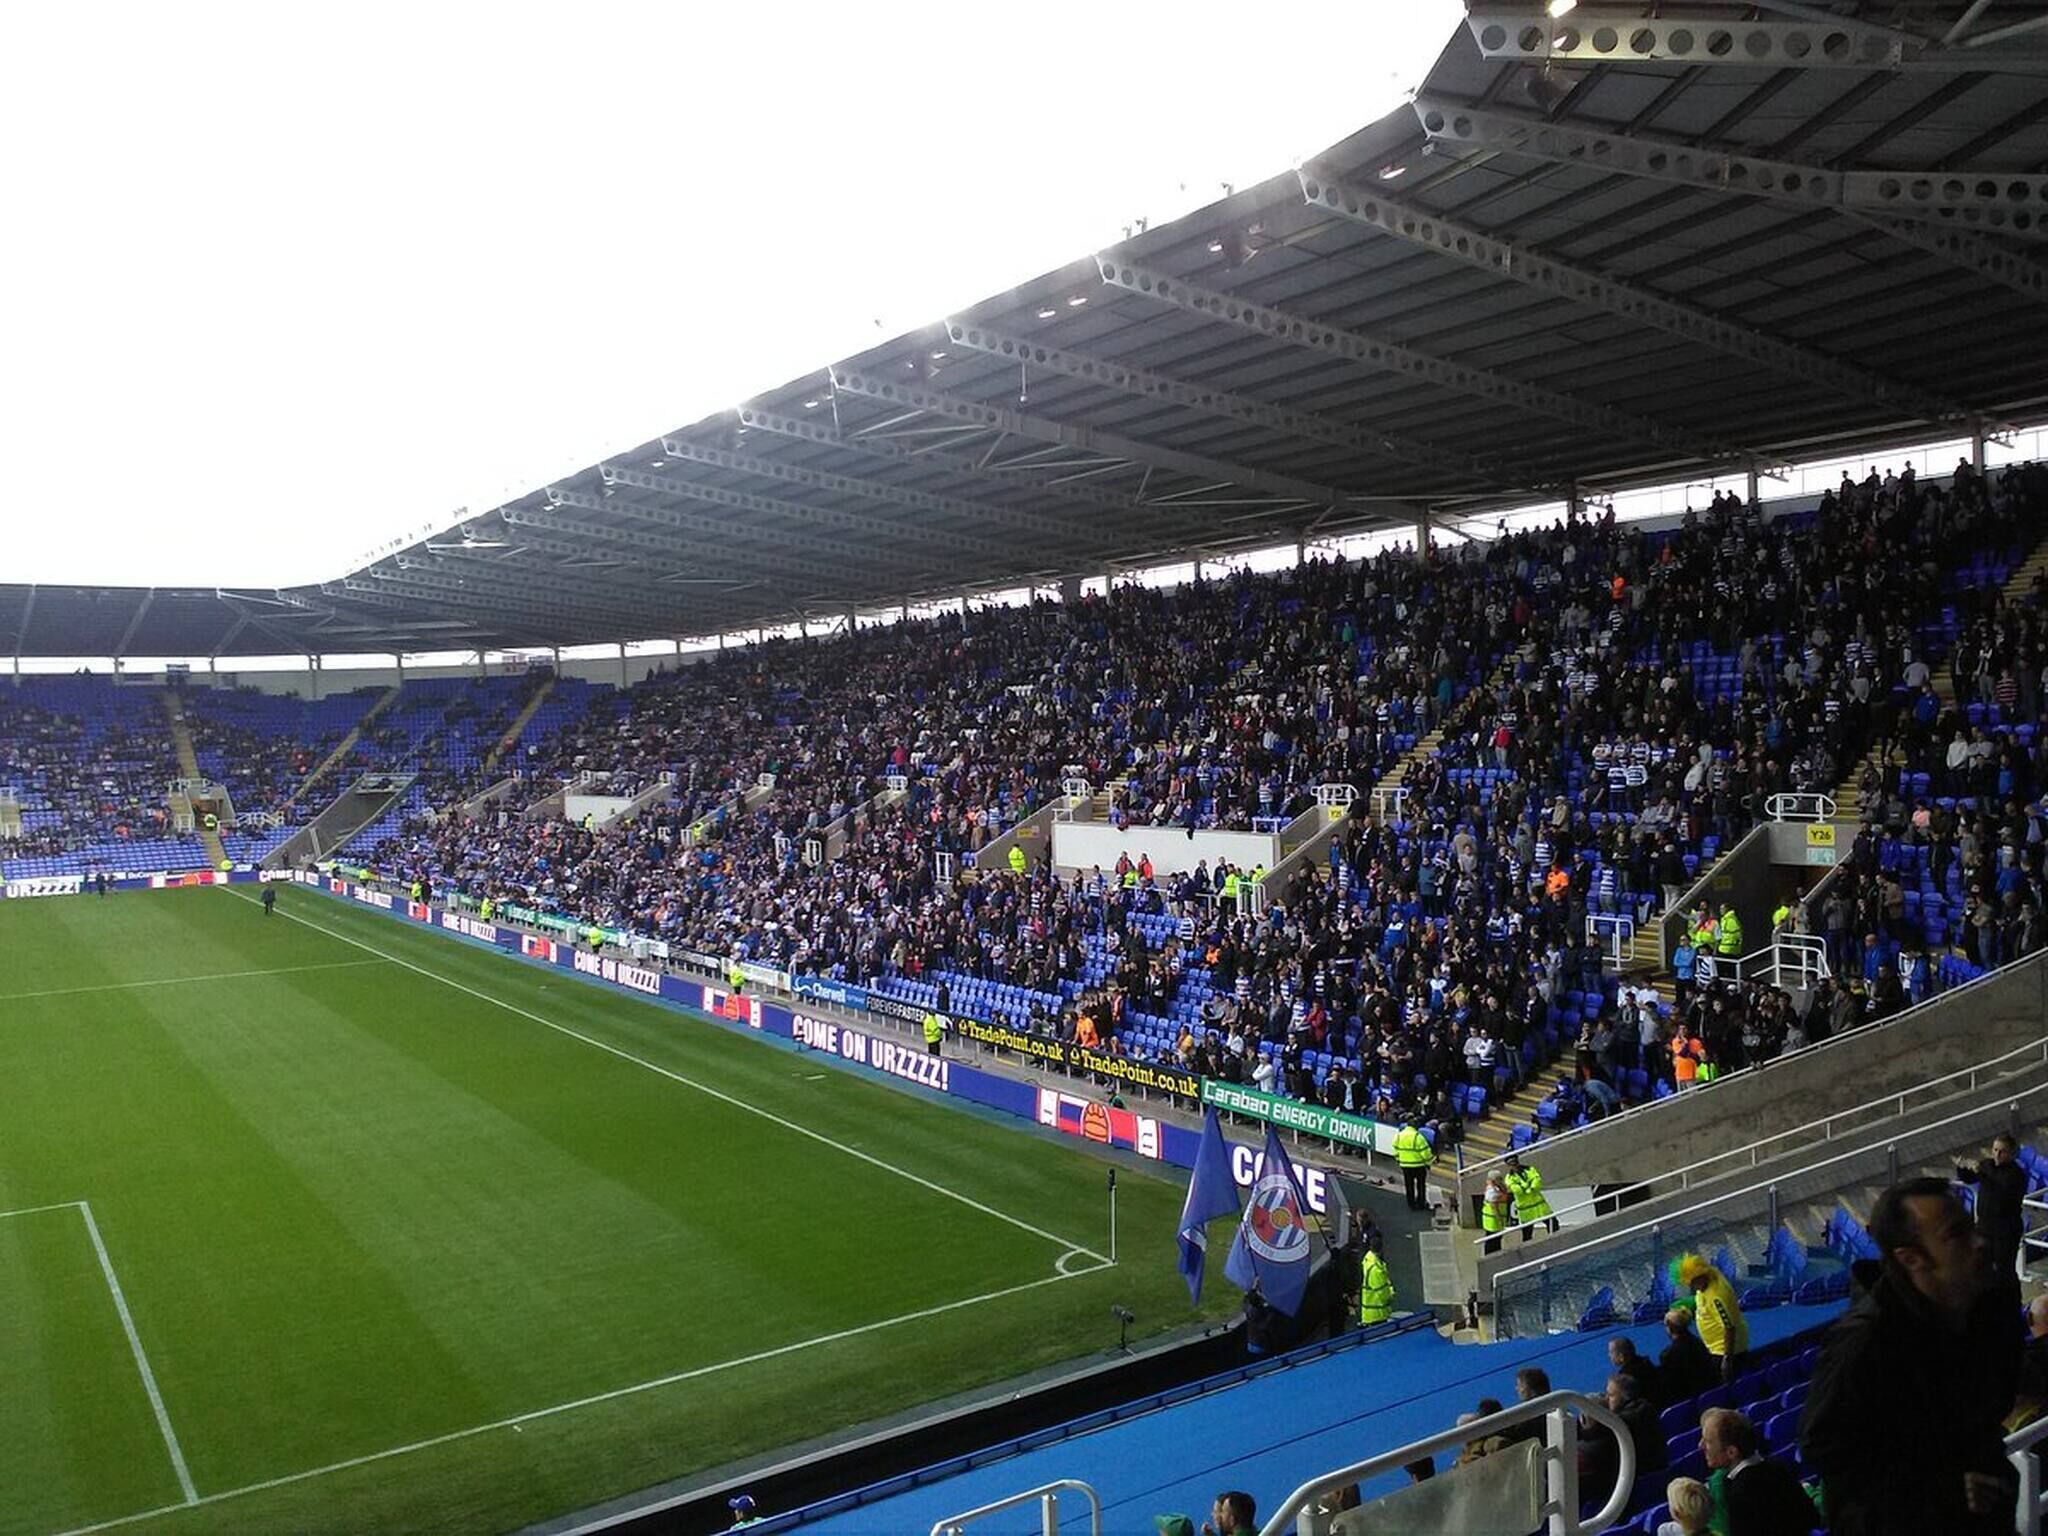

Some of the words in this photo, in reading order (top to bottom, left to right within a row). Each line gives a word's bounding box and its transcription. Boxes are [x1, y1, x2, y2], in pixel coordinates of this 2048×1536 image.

[1810, 830, 1832, 840] Y26
[574, 950, 601, 976] COME
[602, 959, 617, 981] ON
[812, 982, 846, 1004] Cherwell
[792, 1014, 838, 1054] COME
[841, 1030, 867, 1063] ON
[870, 1040, 949, 1091] URZZZZ!
[968, 1020, 1065, 1061] TradePoint.co.uk
[1081, 1048, 1199, 1098] TradePoint.co.uk
[1204, 1080, 1270, 1115] Carabao
[1273, 1103, 1327, 1132] ENERGY
[1329, 1118, 1373, 1145] DRINK
